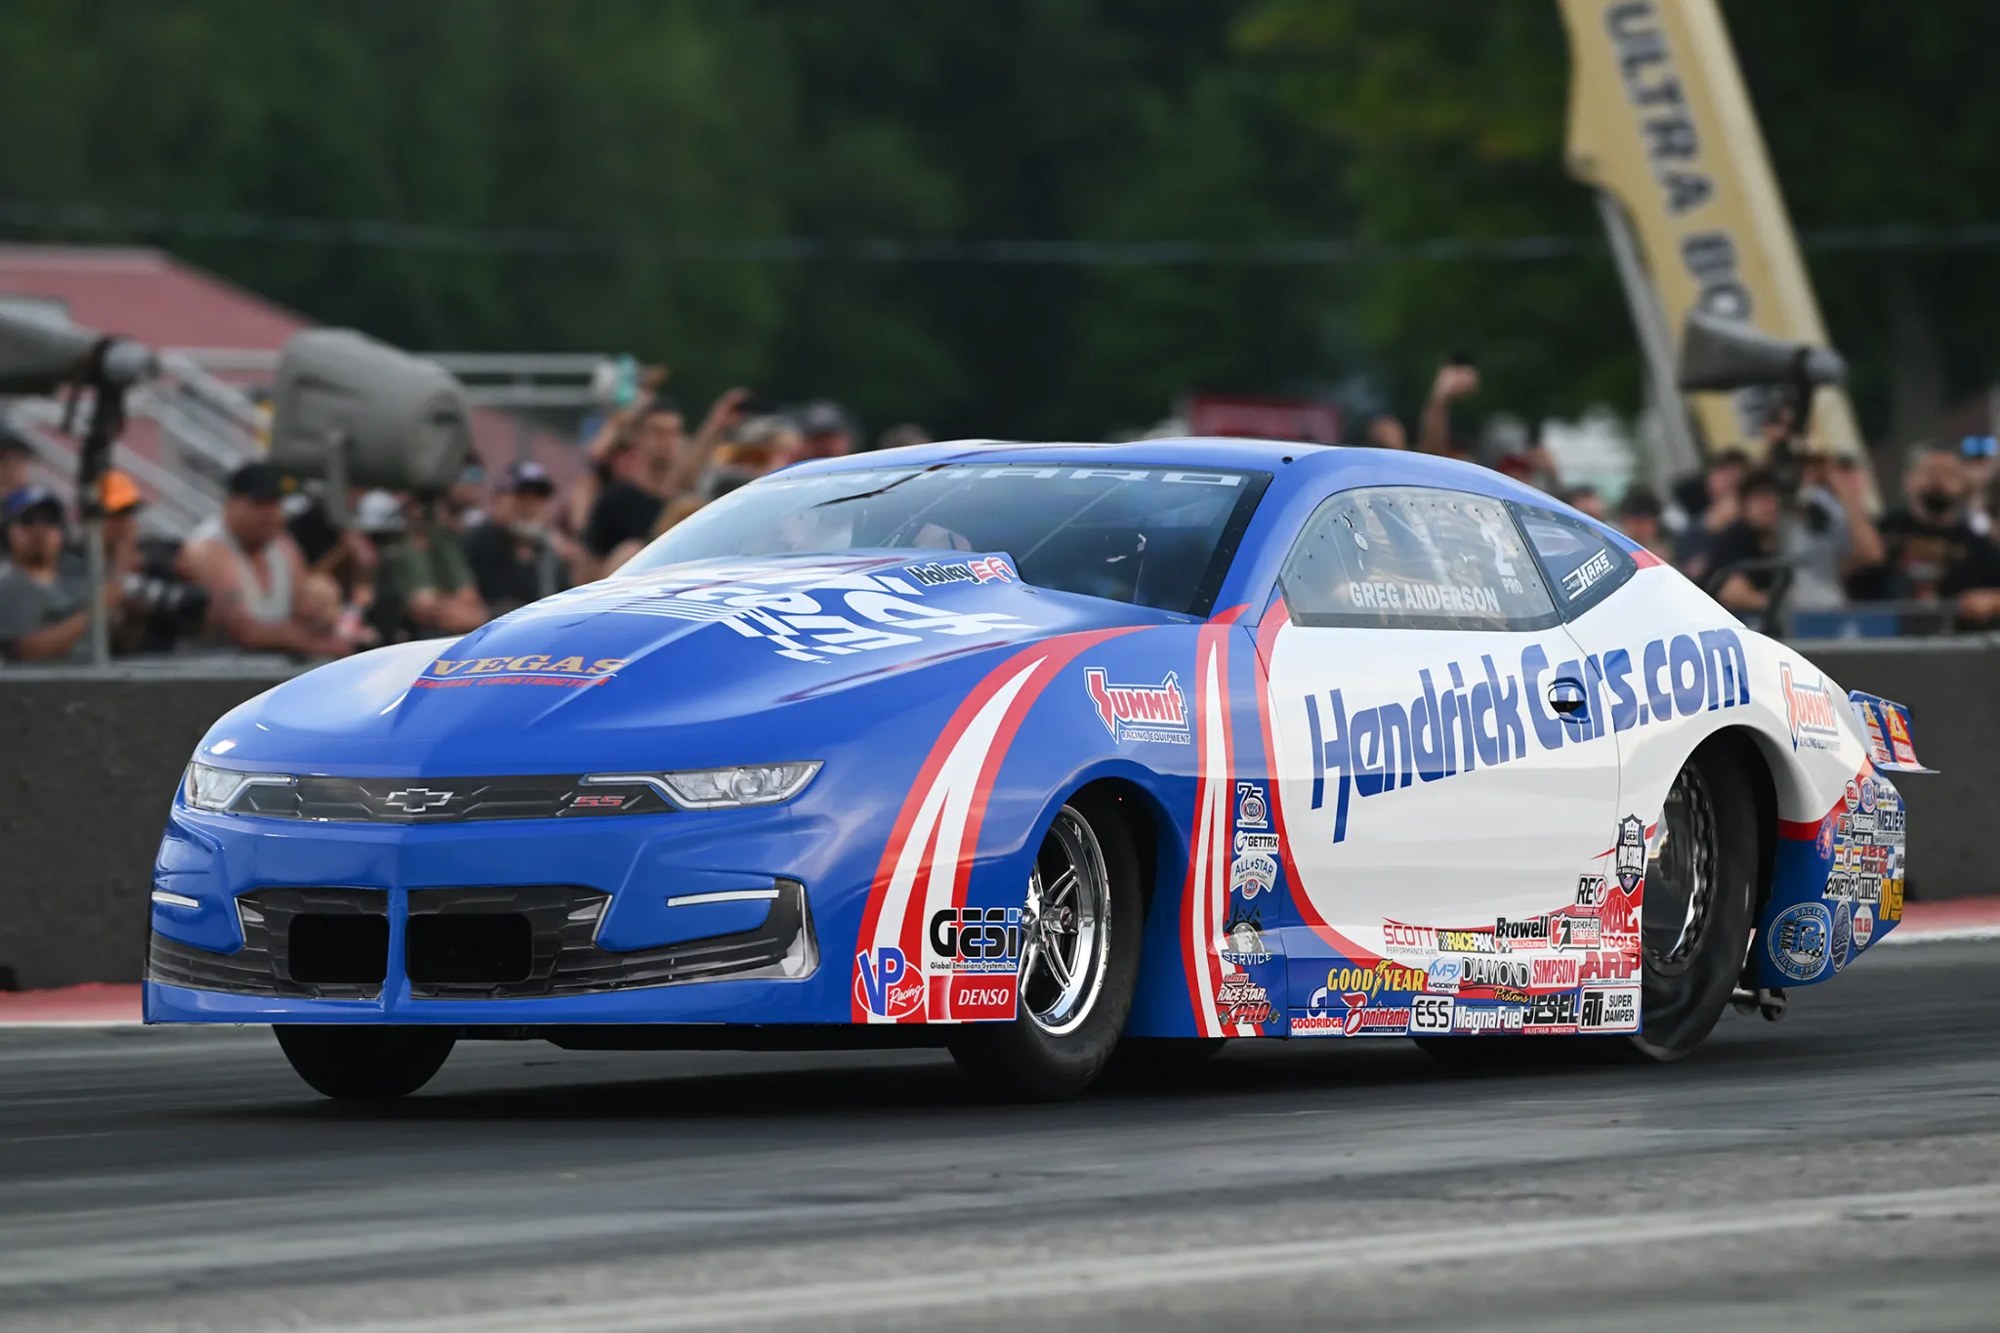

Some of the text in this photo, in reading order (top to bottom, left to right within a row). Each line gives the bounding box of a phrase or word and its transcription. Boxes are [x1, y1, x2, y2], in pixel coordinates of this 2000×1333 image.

[1606, 0, 1715, 215] ULTRA
[903, 562, 981, 586] Holley
[1562, 548, 1611, 600] HAAS
[1350, 581, 1500, 612] GREG ANDERSON
[1503, 578, 1524, 594] PRO
[432, 655, 630, 676] VEGAS
[1087, 669, 1187, 738] SUMMIT
[1781, 665, 1837, 738] SUMMIT
[1121, 730, 1190, 744] RACING EQUIPMENT
[1304, 627, 1750, 844] HendrickCars.com
[1237, 784, 1264, 823] 75
[1846, 786, 1858, 800] BELL
[1879, 810, 1905, 832] MEZIER
[1248, 836, 1278, 847] GETTRX
[1235, 858, 1274, 877] ALL STAR
[1794, 907, 1825, 919] RACING
[930, 908, 1019, 959] GESI
[1383, 924, 1433, 947] SCOTT
[1496, 916, 1548, 939] Browell
[1572, 930, 1599, 939] BATTERIES
[1386, 946, 1424, 956] PERFORMANCE
[1447, 931, 1495, 952] RACEPAK
[1602, 935, 1640, 949] TOOLS
[930, 962, 951, 970] Global
[953, 962, 981, 970] Emissions
[982, 962, 1006, 972] Systems
[1223, 951, 1272, 966] SERVICE
[1581, 951, 1641, 979] ARP
[1776, 951, 1797, 972] VALVE
[858, 947, 906, 1016] VP
[1462, 957, 1531, 989] DIAMOND
[1533, 959, 1576, 985] SIMPSON
[889, 983, 925, 1010] Racing
[958, 989, 1009, 1006] DENSO
[1217, 987, 1266, 1001] RACE STAR
[1493, 984, 1530, 1004] Pistons
[1232, 1002, 1272, 1024] PRO
[1341, 991, 1410, 1036] Boninfante
[1416, 1000, 1449, 1028] ESS
[1523, 995, 1578, 1024] JESEL
[1582, 992, 1632, 1026] ATI SUPER
[1604, 1008, 1635, 1024] DAMPER
[1291, 1018, 1343, 1029] GOODRIDGE
[1454, 1006, 1524, 1035] MagnaFuel
